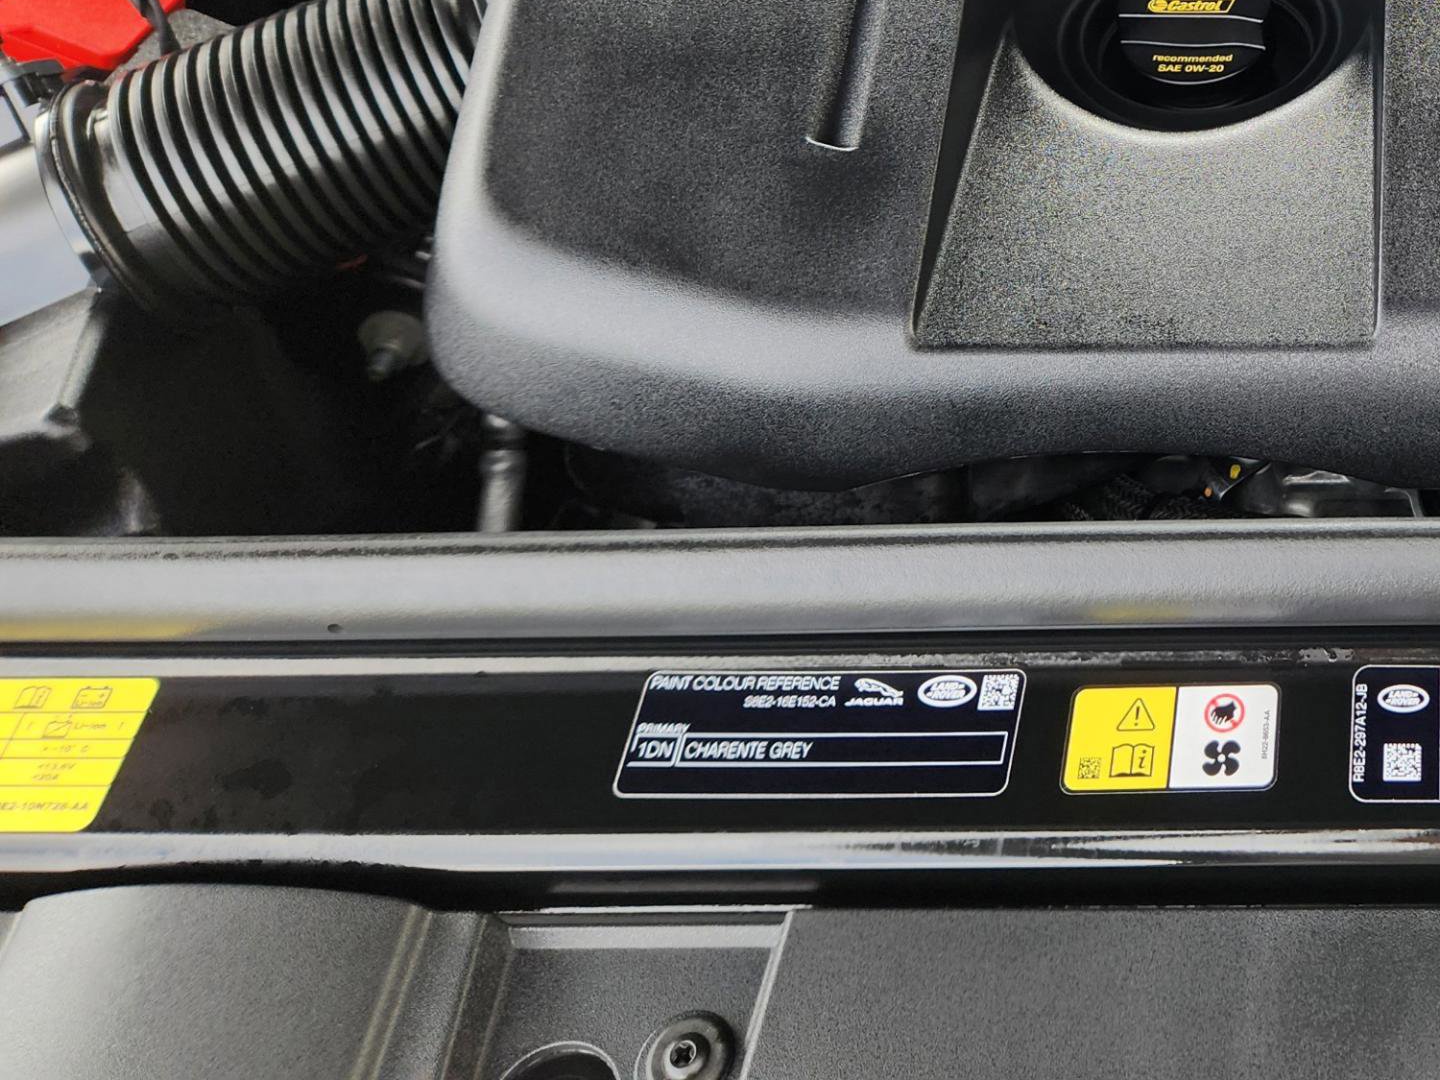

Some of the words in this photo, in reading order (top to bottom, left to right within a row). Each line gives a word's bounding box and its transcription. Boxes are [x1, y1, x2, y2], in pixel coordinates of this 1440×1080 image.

[1167, 0, 1223, 12] Castrol
[1152, 53, 1233, 63] recommended
[1157, 64, 1182, 72] SAE
[1185, 64, 1225, 73] 0W-20
[650, 675, 694, 690] PAINT
[692, 676, 755, 691] COLOUR
[756, 676, 841, 690] REFERENCE
[930, 682, 959, 691] LAND
[932, 690, 966, 700] ROVER
[844, 697, 904, 707] JAGUAR
[636, 723, 691, 734] PRIMARY
[637, 740, 675, 759] 1DN
[684, 741, 768, 760] CHARENTE
[768, 741, 814, 760] GREY
